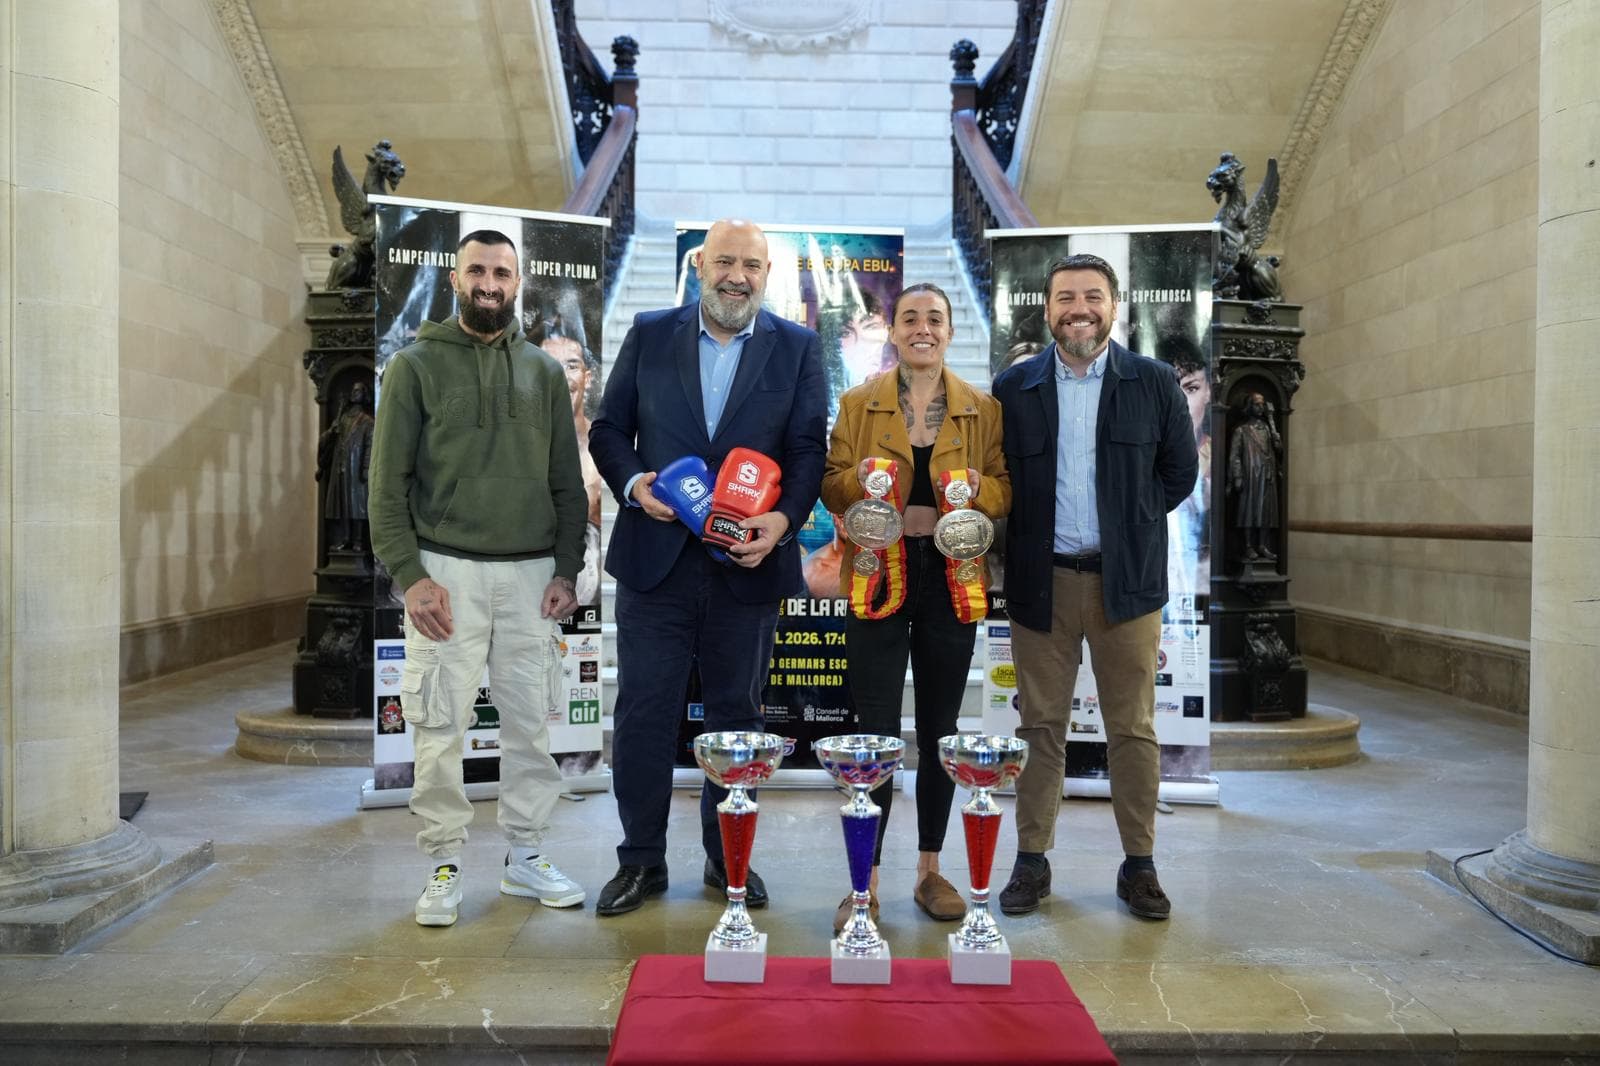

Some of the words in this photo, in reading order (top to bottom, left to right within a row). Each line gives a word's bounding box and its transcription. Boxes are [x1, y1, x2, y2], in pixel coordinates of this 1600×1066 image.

[389, 247, 456, 268] CAMPEONATO
[530, 260, 561, 277] SUPER
[565, 263, 597, 280] PLUMA
[1132, 289, 1192, 303] SUPERMOSCA
[727, 482, 760, 499] SHARK
[787, 598, 807, 616] DE
[810, 598, 831, 616] LA
[785, 632, 822, 645] 2026.
[779, 658, 826, 669] GERMANS
[770, 674, 783, 685] DE
[786, 674, 844, 686] MALLORCA)
[570, 687, 598, 699] REN
[571, 701, 597, 722] air
